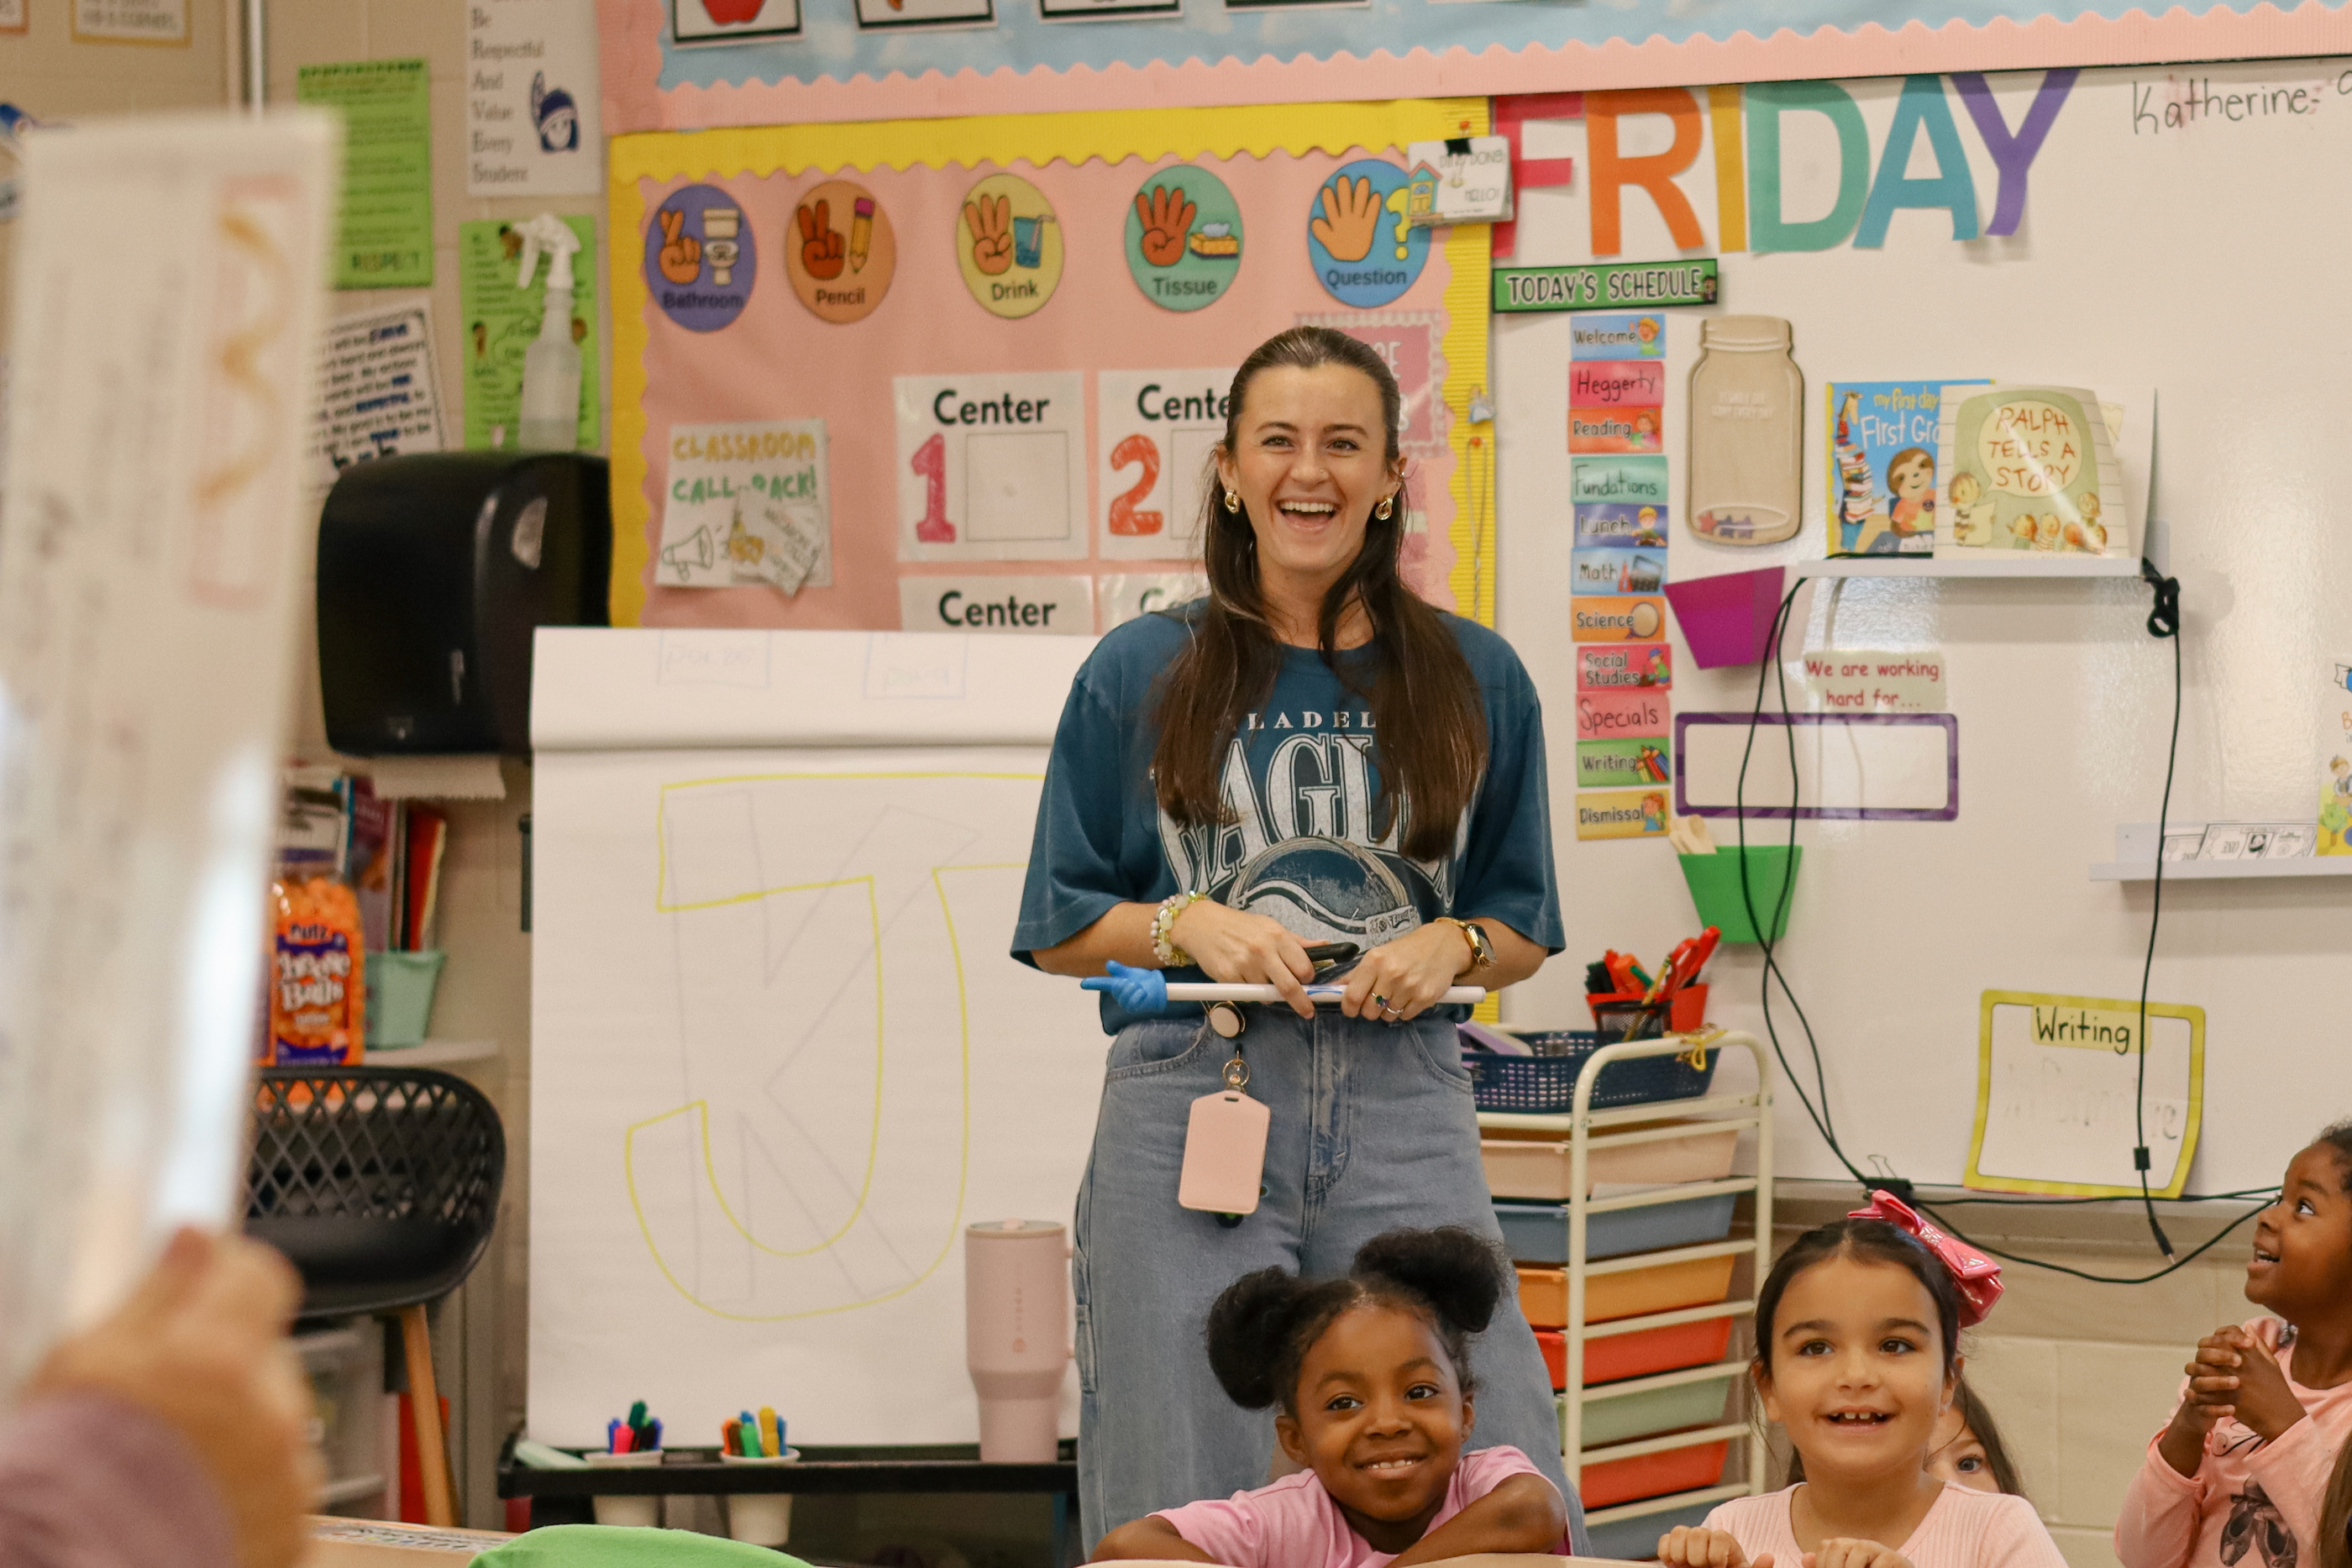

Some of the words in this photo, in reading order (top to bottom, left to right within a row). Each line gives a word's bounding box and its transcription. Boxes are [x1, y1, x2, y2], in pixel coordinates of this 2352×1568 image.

[1492, 69, 2081, 257] FRIDAY
[1153, 277, 1217, 295] Tissue
[1326, 269, 1407, 287] Question
[1507, 272, 1598, 304] TODAY'S
[1608, 268, 1703, 300] SCHEDULE
[664, 289, 744, 310] Bathroom
[816, 287, 865, 305] Pencil
[991, 280, 1039, 302] Drink
[1574, 328, 1637, 346] Welcome
[1577, 369, 1656, 402] Heggerty
[933, 389, 1051, 425] Center
[1137, 384, 1231, 421] Cente
[1873, 394, 1890, 411] my
[1892, 387, 1917, 412] first
[1919, 385, 1940, 412] day
[1573, 418, 1632, 439] Reading
[1860, 411, 1907, 450] First
[1995, 406, 2069, 435] RALPH
[673, 430, 816, 463] CLASSROOM
[1987, 440, 2051, 459] TELLS
[2061, 442, 2076, 460] A
[911, 433, 957, 543] 1
[1110, 433, 1163, 537] 2
[1574, 464, 1658, 497] Fundations
[1995, 464, 2071, 492] STORY
[1580, 514, 1631, 536] Lunch
[1579, 563, 1619, 581] Math
[938, 590, 1057, 627] Center
[1577, 611, 1635, 628] Science
[1585, 651, 1628, 669] Social
[1805, 660, 1833, 677] We
[1841, 663, 1869, 677] are
[1877, 659, 1940, 682] working
[1586, 669, 1641, 687] Studies
[1826, 689, 1865, 707] hard
[1580, 698, 1659, 736] Specials
[1583, 755, 1638, 774] Writing
[1579, 803, 1645, 825] Dismissal
[2035, 1005, 2130, 1056] Writing
